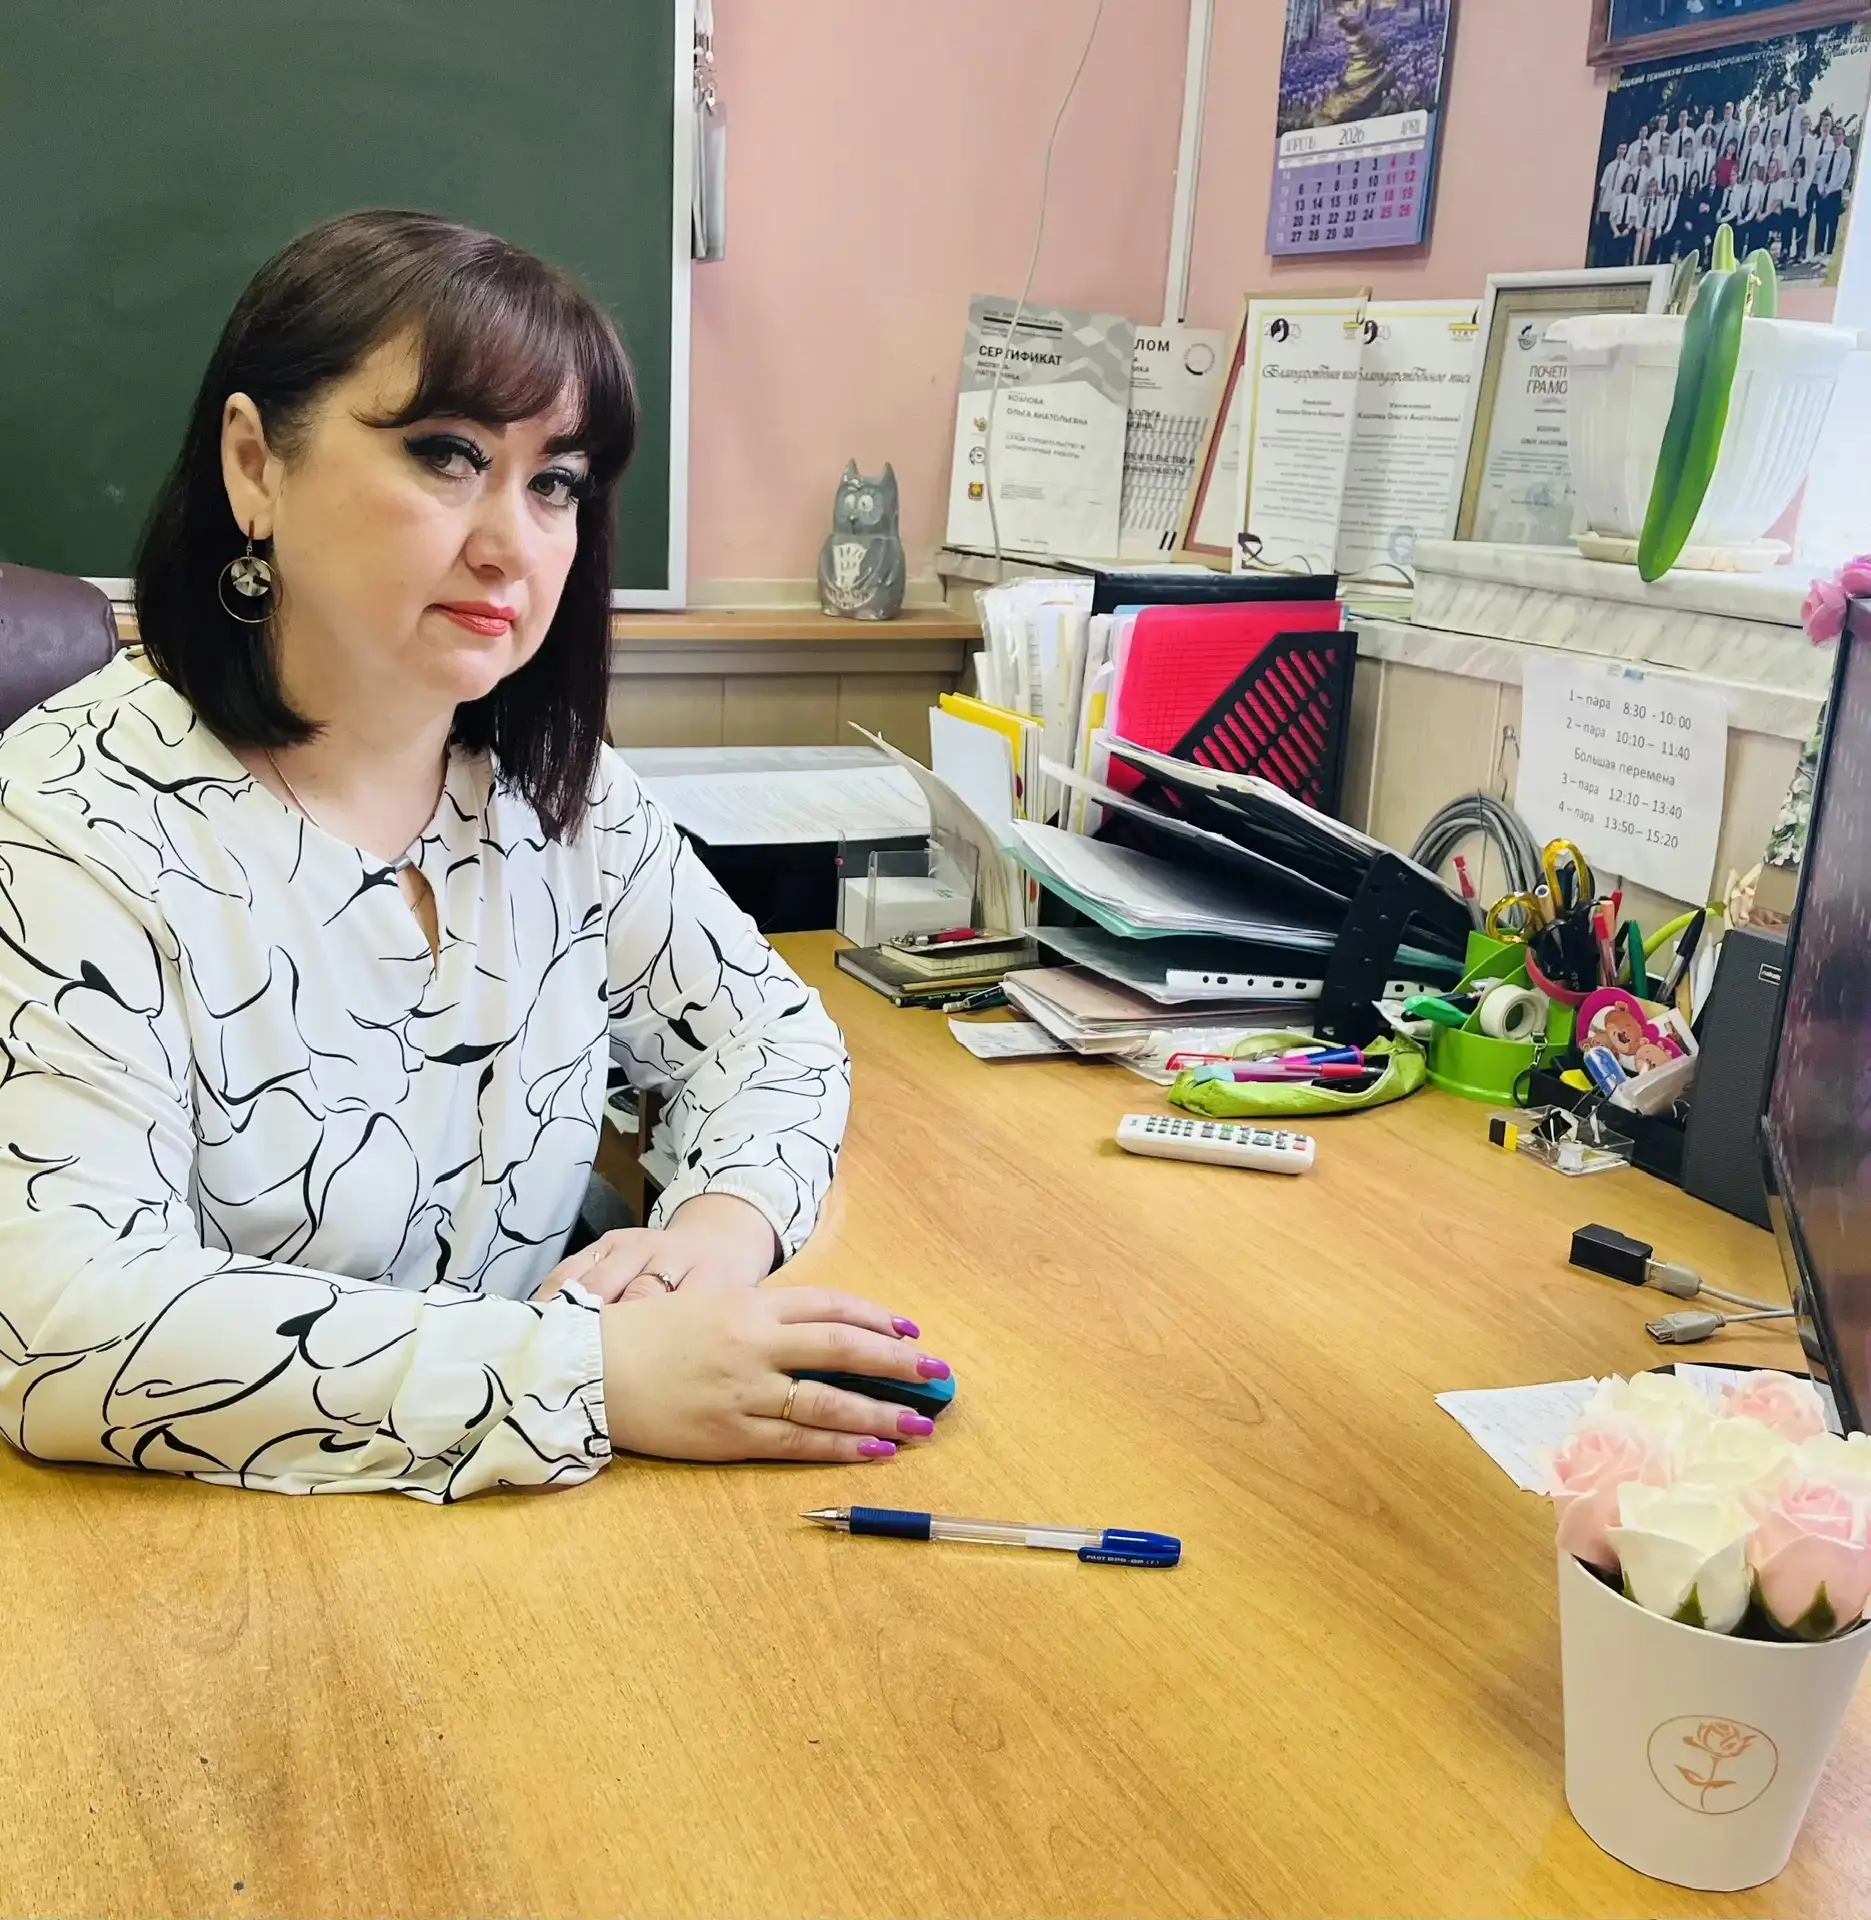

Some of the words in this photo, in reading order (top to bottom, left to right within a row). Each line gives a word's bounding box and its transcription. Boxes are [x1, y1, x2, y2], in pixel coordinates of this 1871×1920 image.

[1339, 126, 1365, 145] 2026
[1337, 163, 1341, 175] 1
[1354, 161, 1359, 173] 2
[1373, 158, 1378, 170] 3
[1299, 184, 1304, 195] 6
[1317, 182, 1322, 192] 7
[1335, 180, 1339, 191] 8
[1352, 178, 1358, 189] 9
[1369, 175, 1378, 187] 10
[1295, 200, 1305, 211] 13
[1313, 198, 1322, 209] 14
[1331, 196, 1340, 207] 15
[1348, 194, 1358, 205] 16
[1366, 192, 1376, 204] 17
[1293, 216, 1303, 227] 20
[1310, 215, 1320, 225] 21
[1328, 213, 1338, 224] 22
[1345, 211, 1356, 222] 23
[1363, 209, 1373, 220] 24
[1291, 232, 1301, 242] 27
[1309, 230, 1319, 241] 28
[1326, 229, 1337, 239] 29
[1343, 227, 1354, 238] 30
[979, 345, 1063, 365] СЕРТИФИКАТ
[1134, 339, 1170, 352] ЛОМ
[1569, 689, 1574, 701] 1
[1586, 694, 1611, 710] пара
[1623, 702, 1646, 719] 8:30
[1566, 717, 1572, 729] 2
[1583, 723, 1606, 738] пара
[1616, 731, 1645, 748] 10:10
[1661, 742, 1690, 761] 11:40
[1574, 747, 1615, 770] Большая
[1619, 763, 1675, 786] перемена
[1561, 772, 1567, 784] 3
[1578, 779, 1599, 795] пара
[1608, 788, 1640, 807] 12:10
[1652, 800, 1683, 819] 13:40
[1558, 801, 1564, 812] 4
[1574, 808, 1594, 823] пара
[1604, 817, 1635, 835] 13:50
[1647, 829, 1678, 849] 15:20
